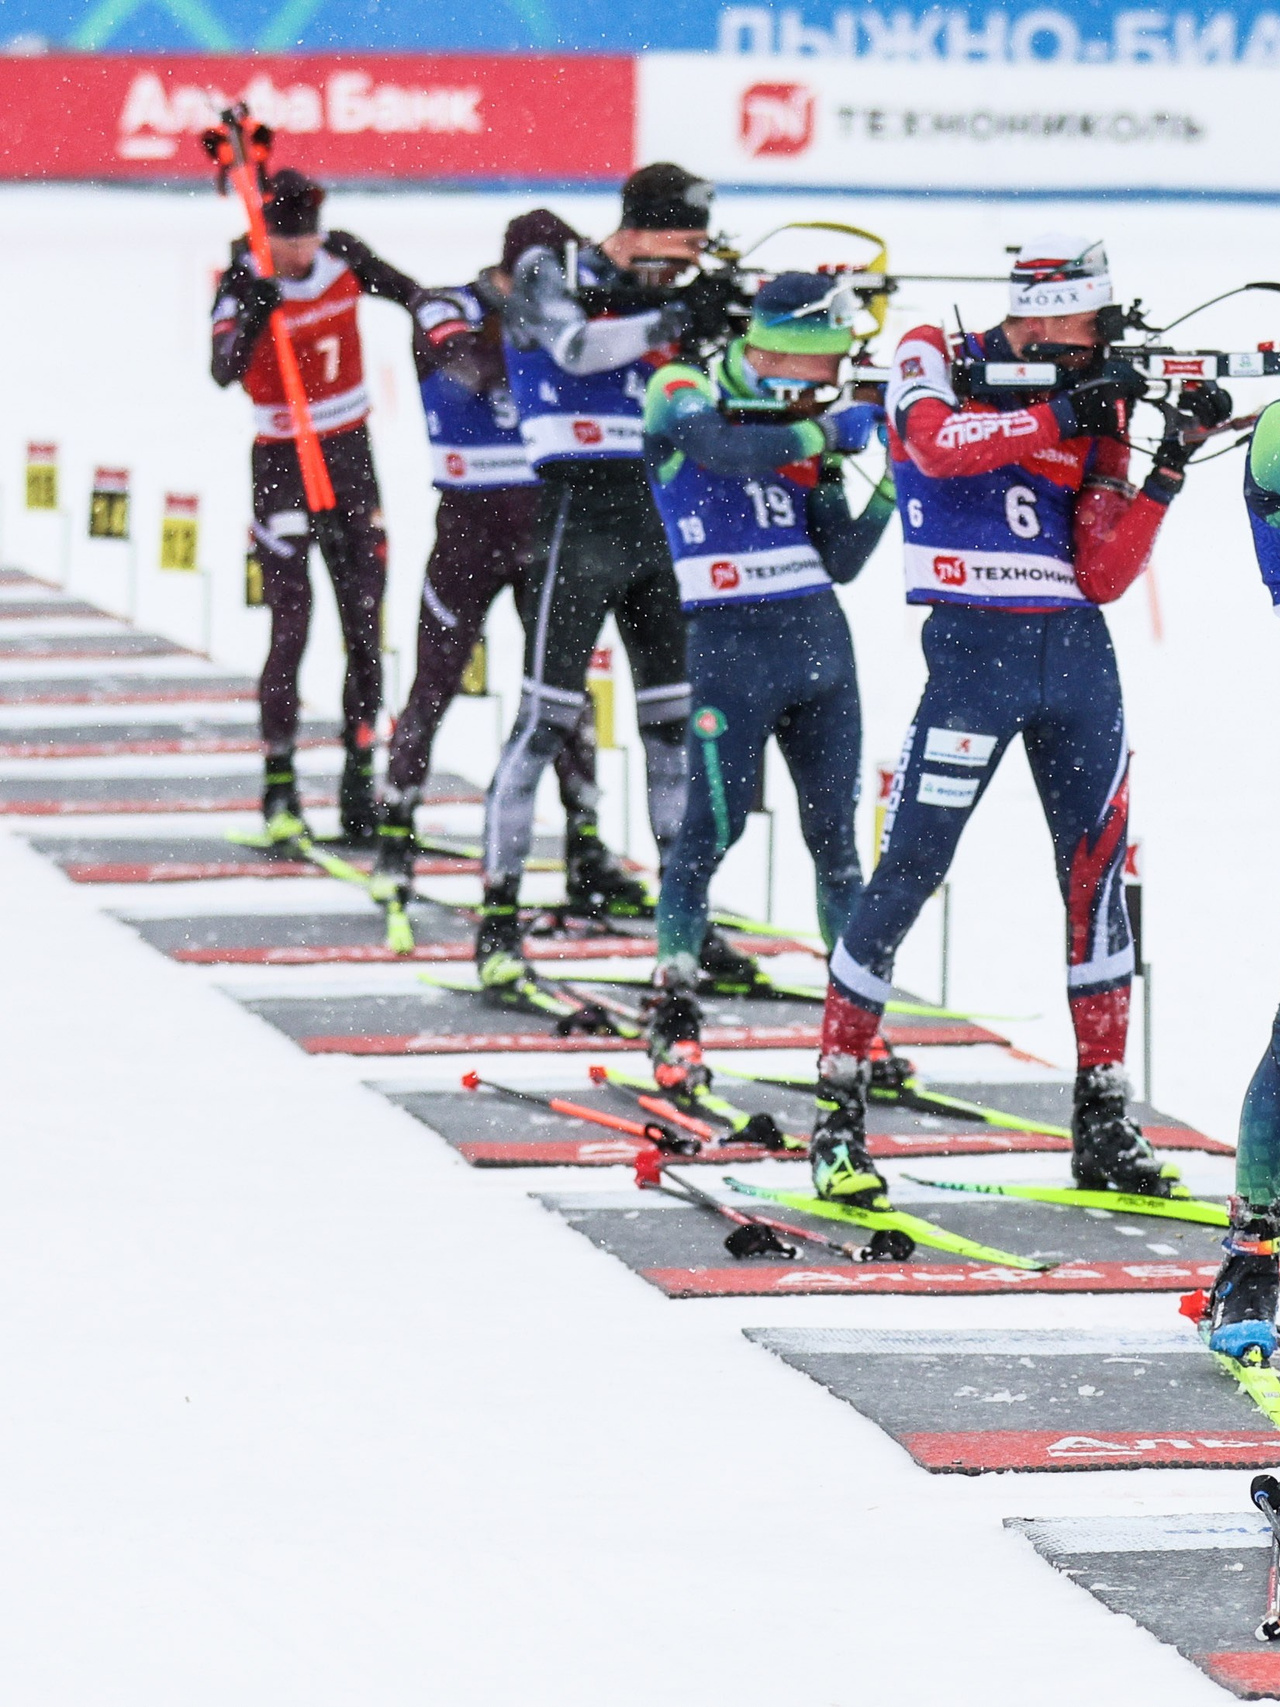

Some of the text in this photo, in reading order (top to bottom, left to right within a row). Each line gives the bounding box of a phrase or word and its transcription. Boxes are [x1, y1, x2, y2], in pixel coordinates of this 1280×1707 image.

[326, 72, 483, 133] Банк
[744, 481, 796, 529] 19
[907, 498, 923, 528] 6
[1005, 485, 1041, 538] 6
